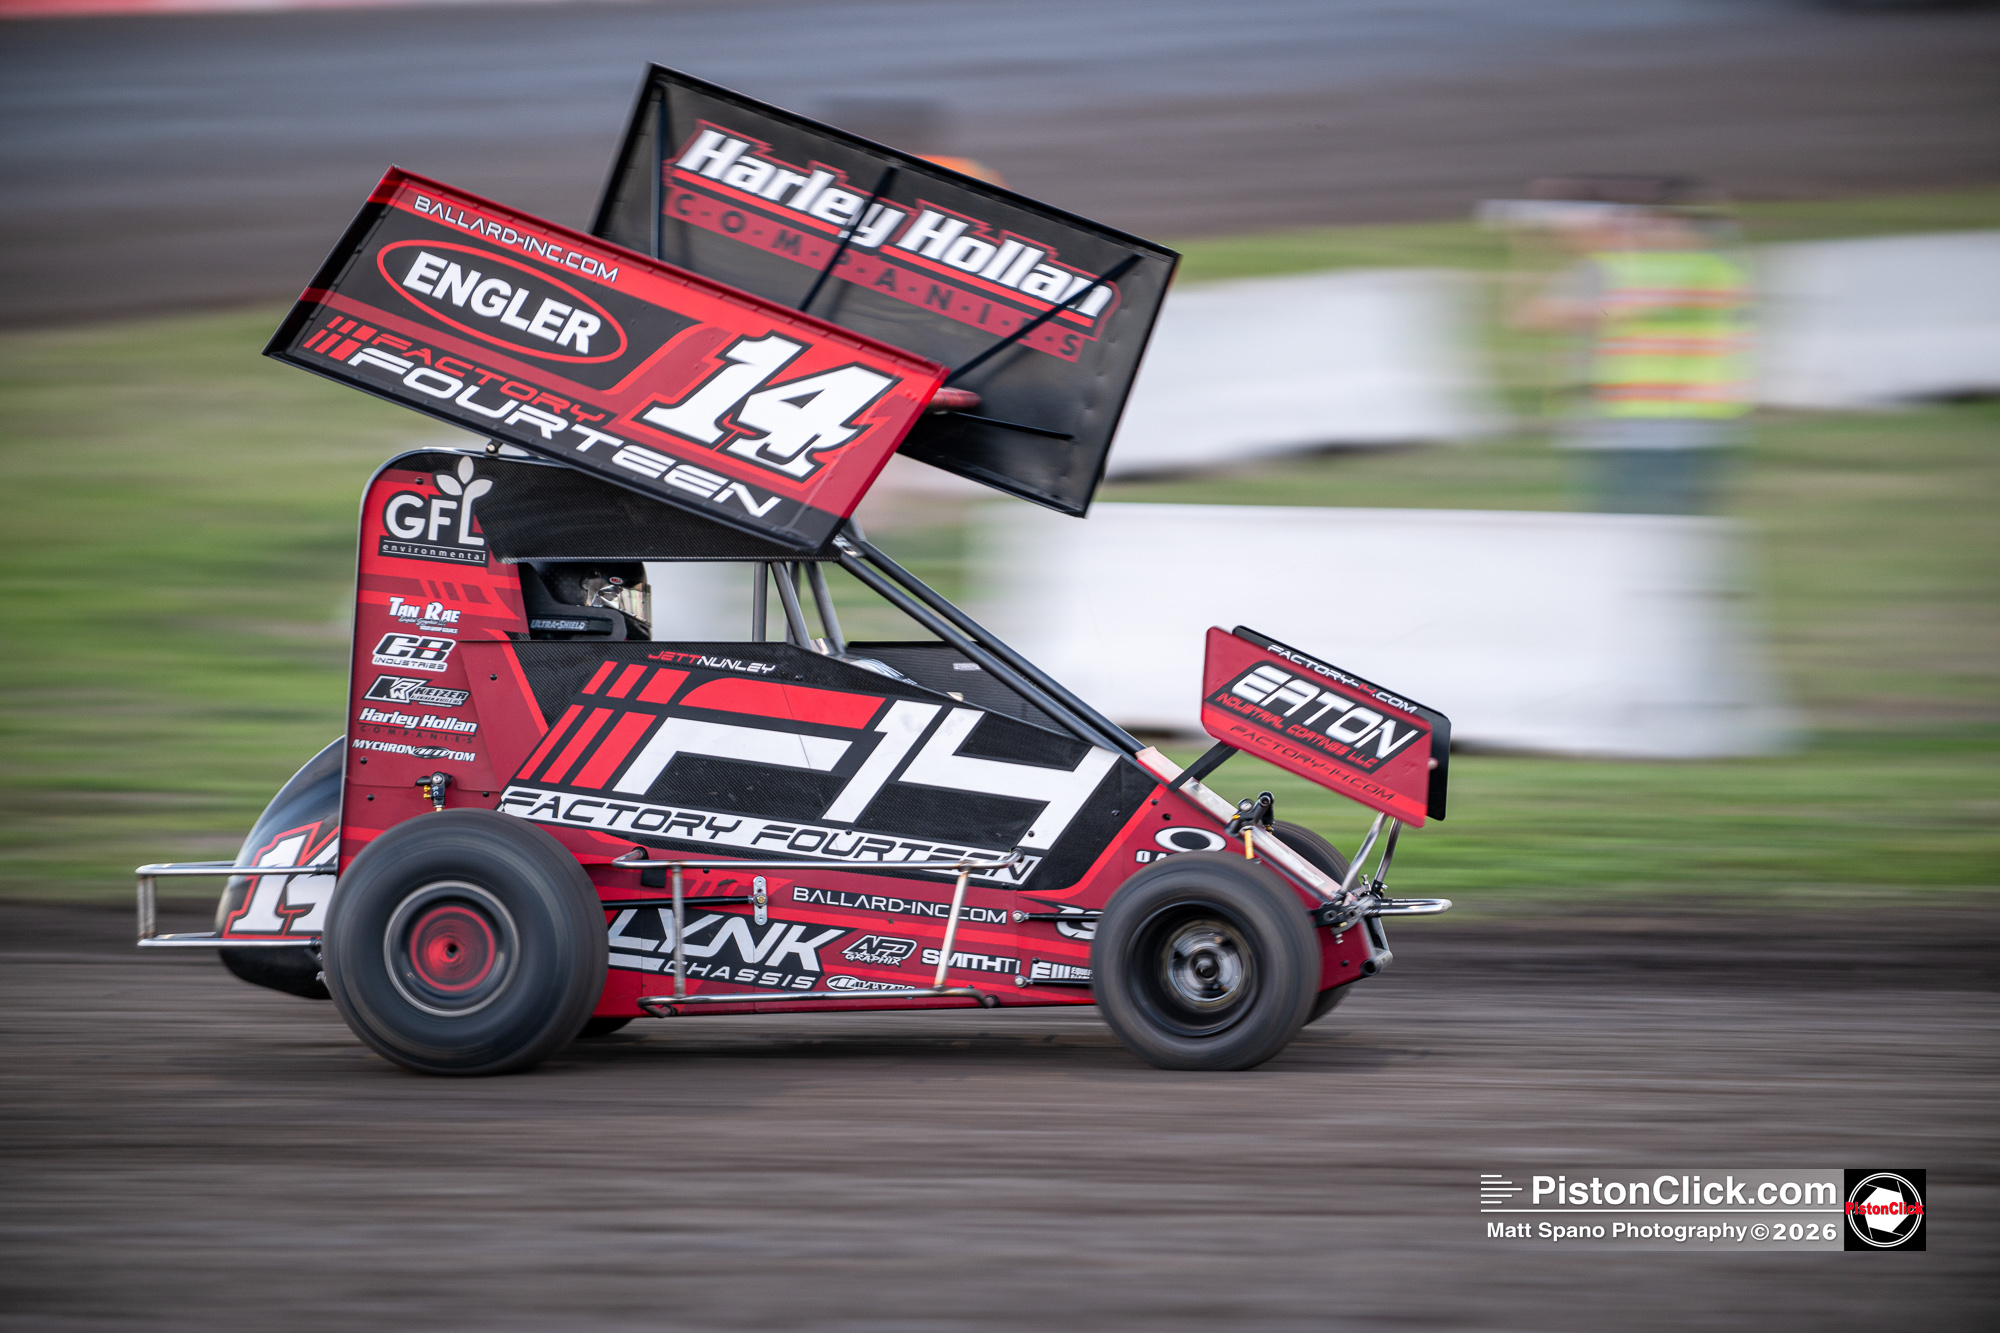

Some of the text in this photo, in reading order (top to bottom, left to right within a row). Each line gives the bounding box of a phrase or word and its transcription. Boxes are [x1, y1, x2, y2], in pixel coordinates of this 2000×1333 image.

[413, 194, 619, 283] BALLARD-INC.COM
[675, 129, 1113, 317] Harley Hollan
[402, 250, 601, 354] ENGLER
[371, 333, 605, 422] FACTORY
[643, 333, 898, 479] 14
[348, 347, 780, 518] FOURTEEN
[381, 542, 487, 562] environmental
[385, 485, 486, 546] GFL
[359, 707, 478, 733] Harley Hollan
[413, 686, 469, 701] KEIZER
[1215, 692, 1380, 769] INDUSTRIAL COATINGS LLC
[1231, 664, 1419, 760] EATON
[502, 790, 1036, 881] FACTORY FOURTEEN
[793, 886, 1008, 925] BALLARD-INCCOM
[663, 960, 816, 990] CHASSIS
